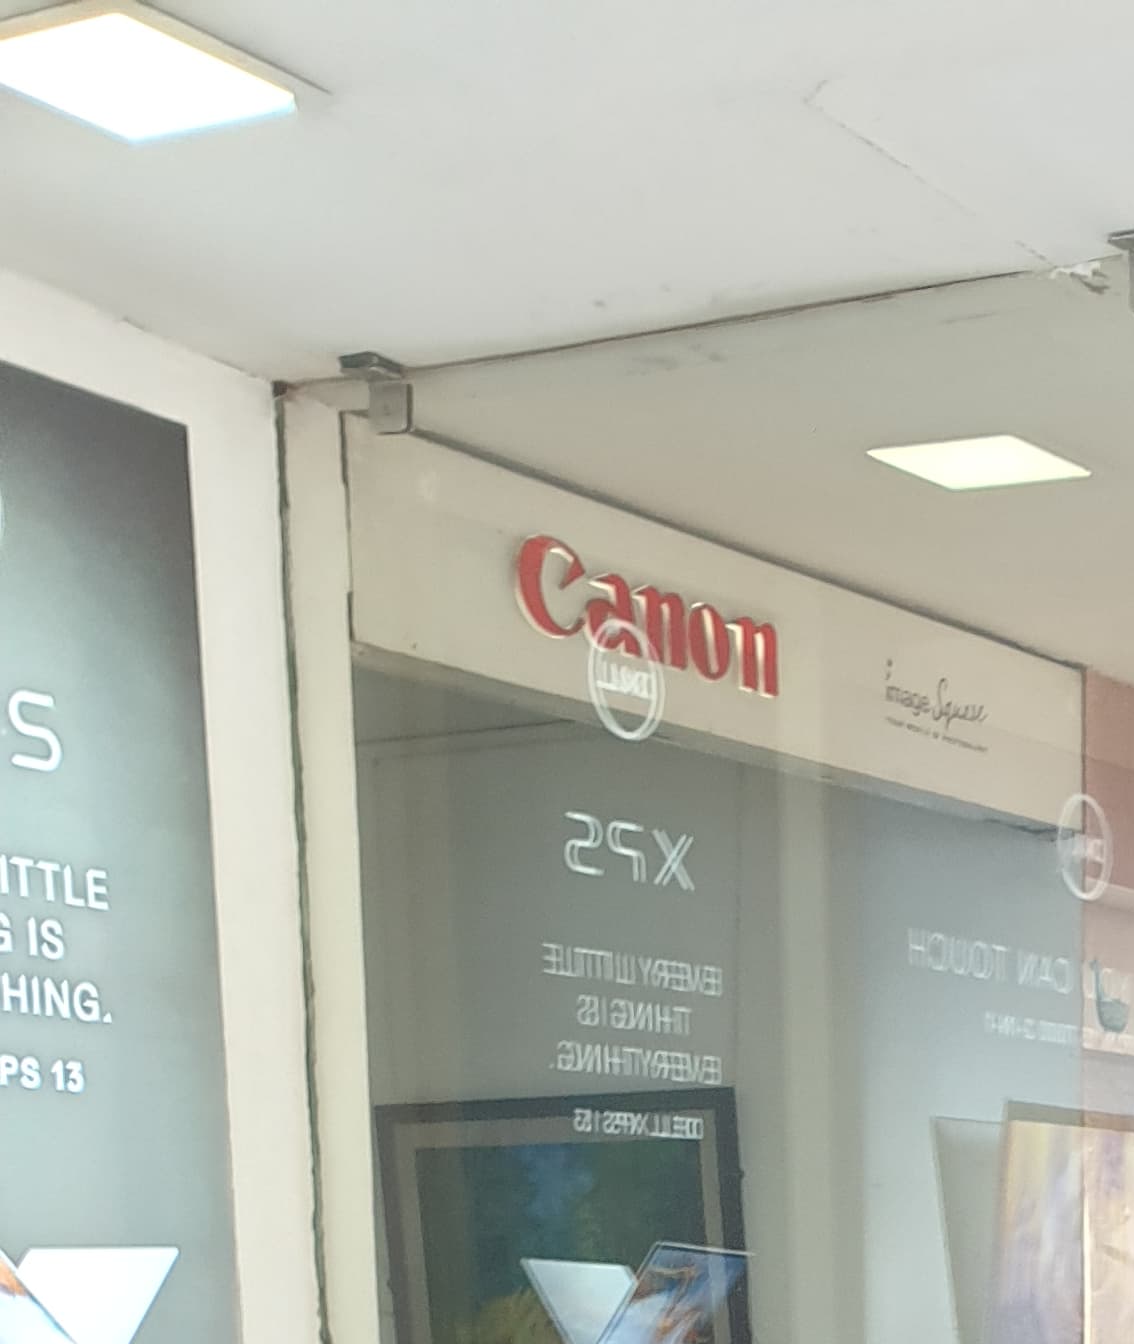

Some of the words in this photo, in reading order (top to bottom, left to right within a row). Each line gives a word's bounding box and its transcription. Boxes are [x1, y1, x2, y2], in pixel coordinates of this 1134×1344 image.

[516, 535, 779, 698] Canon
[27, 916, 66, 961] IS
[51, 1059, 86, 1093] 13
